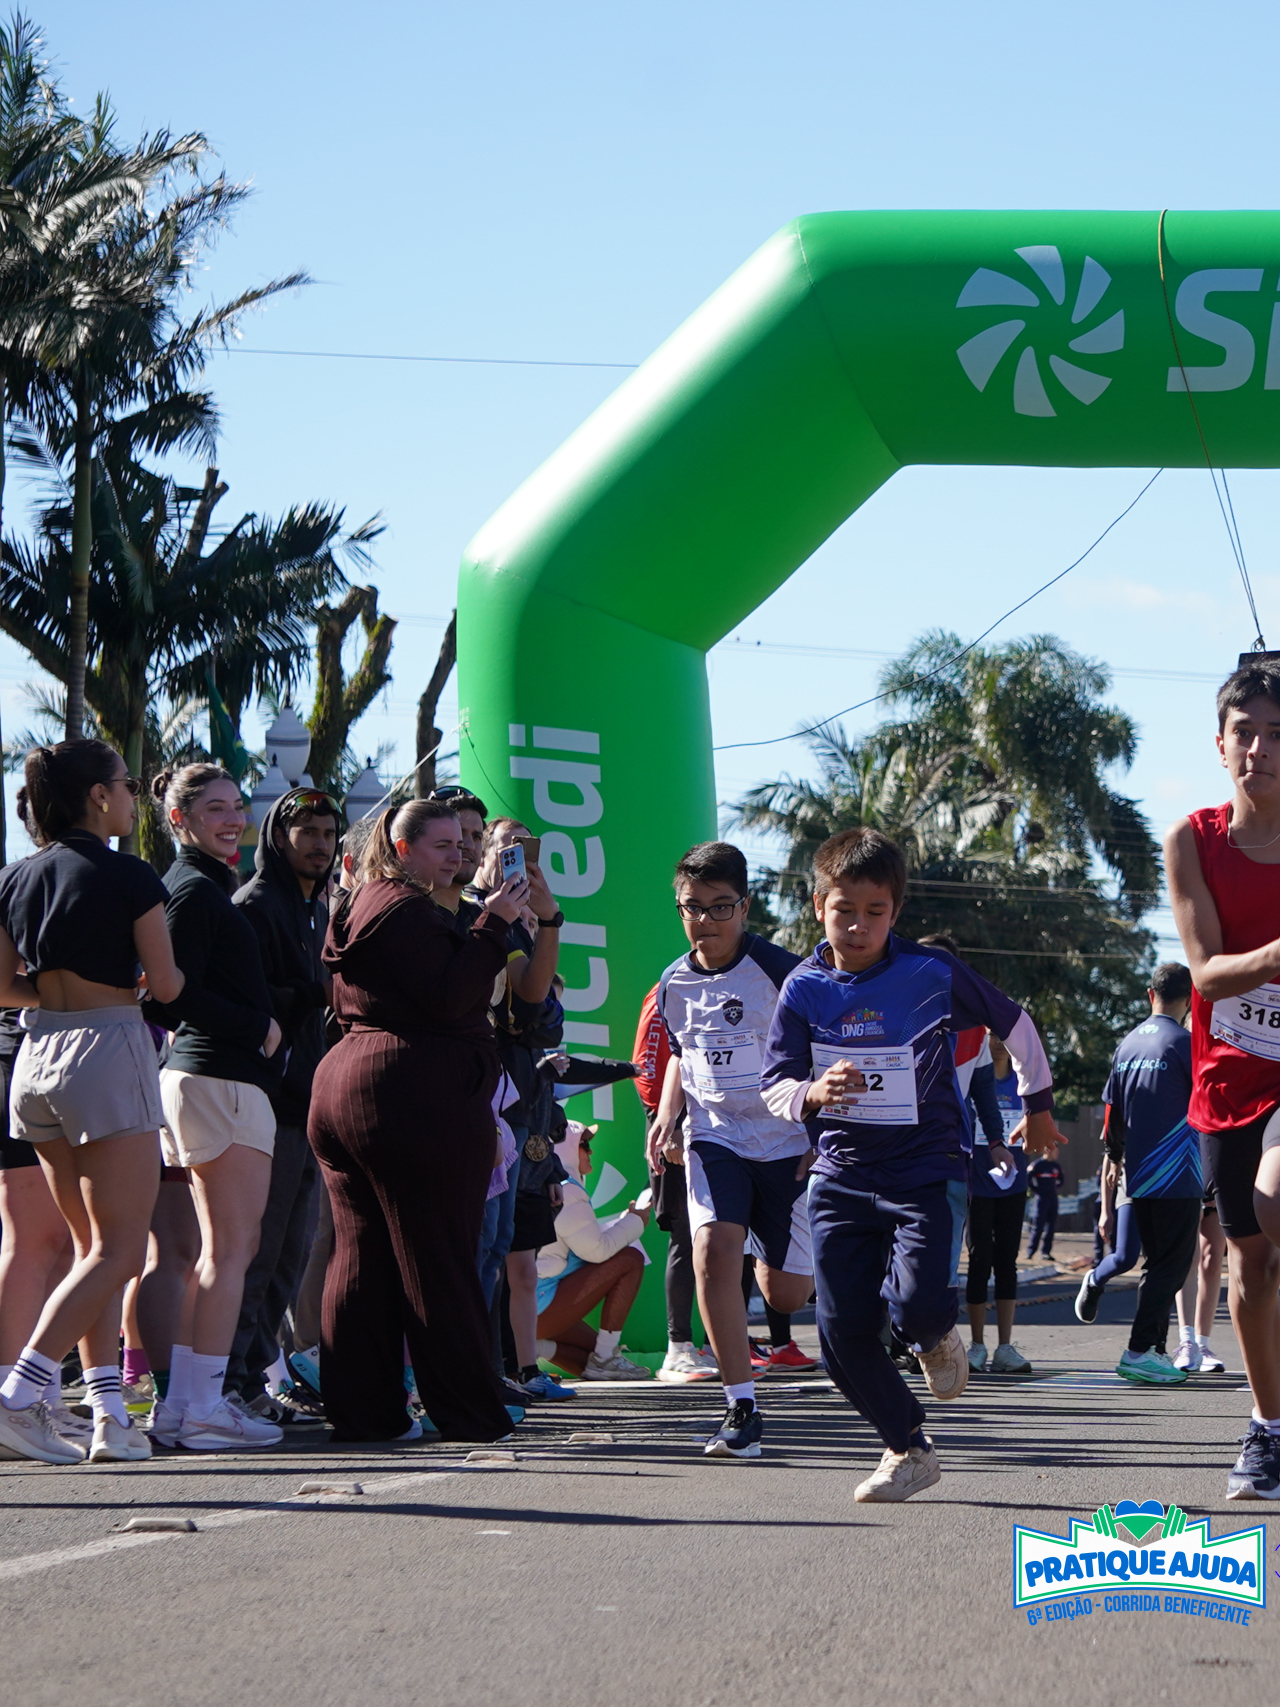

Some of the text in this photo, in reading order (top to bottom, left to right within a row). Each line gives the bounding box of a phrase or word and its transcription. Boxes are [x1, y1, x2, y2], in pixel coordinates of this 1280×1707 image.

[508, 722, 614, 1122] icredi
[841, 1023, 865, 1038] ONG
[703, 1050, 734, 1066] 127
